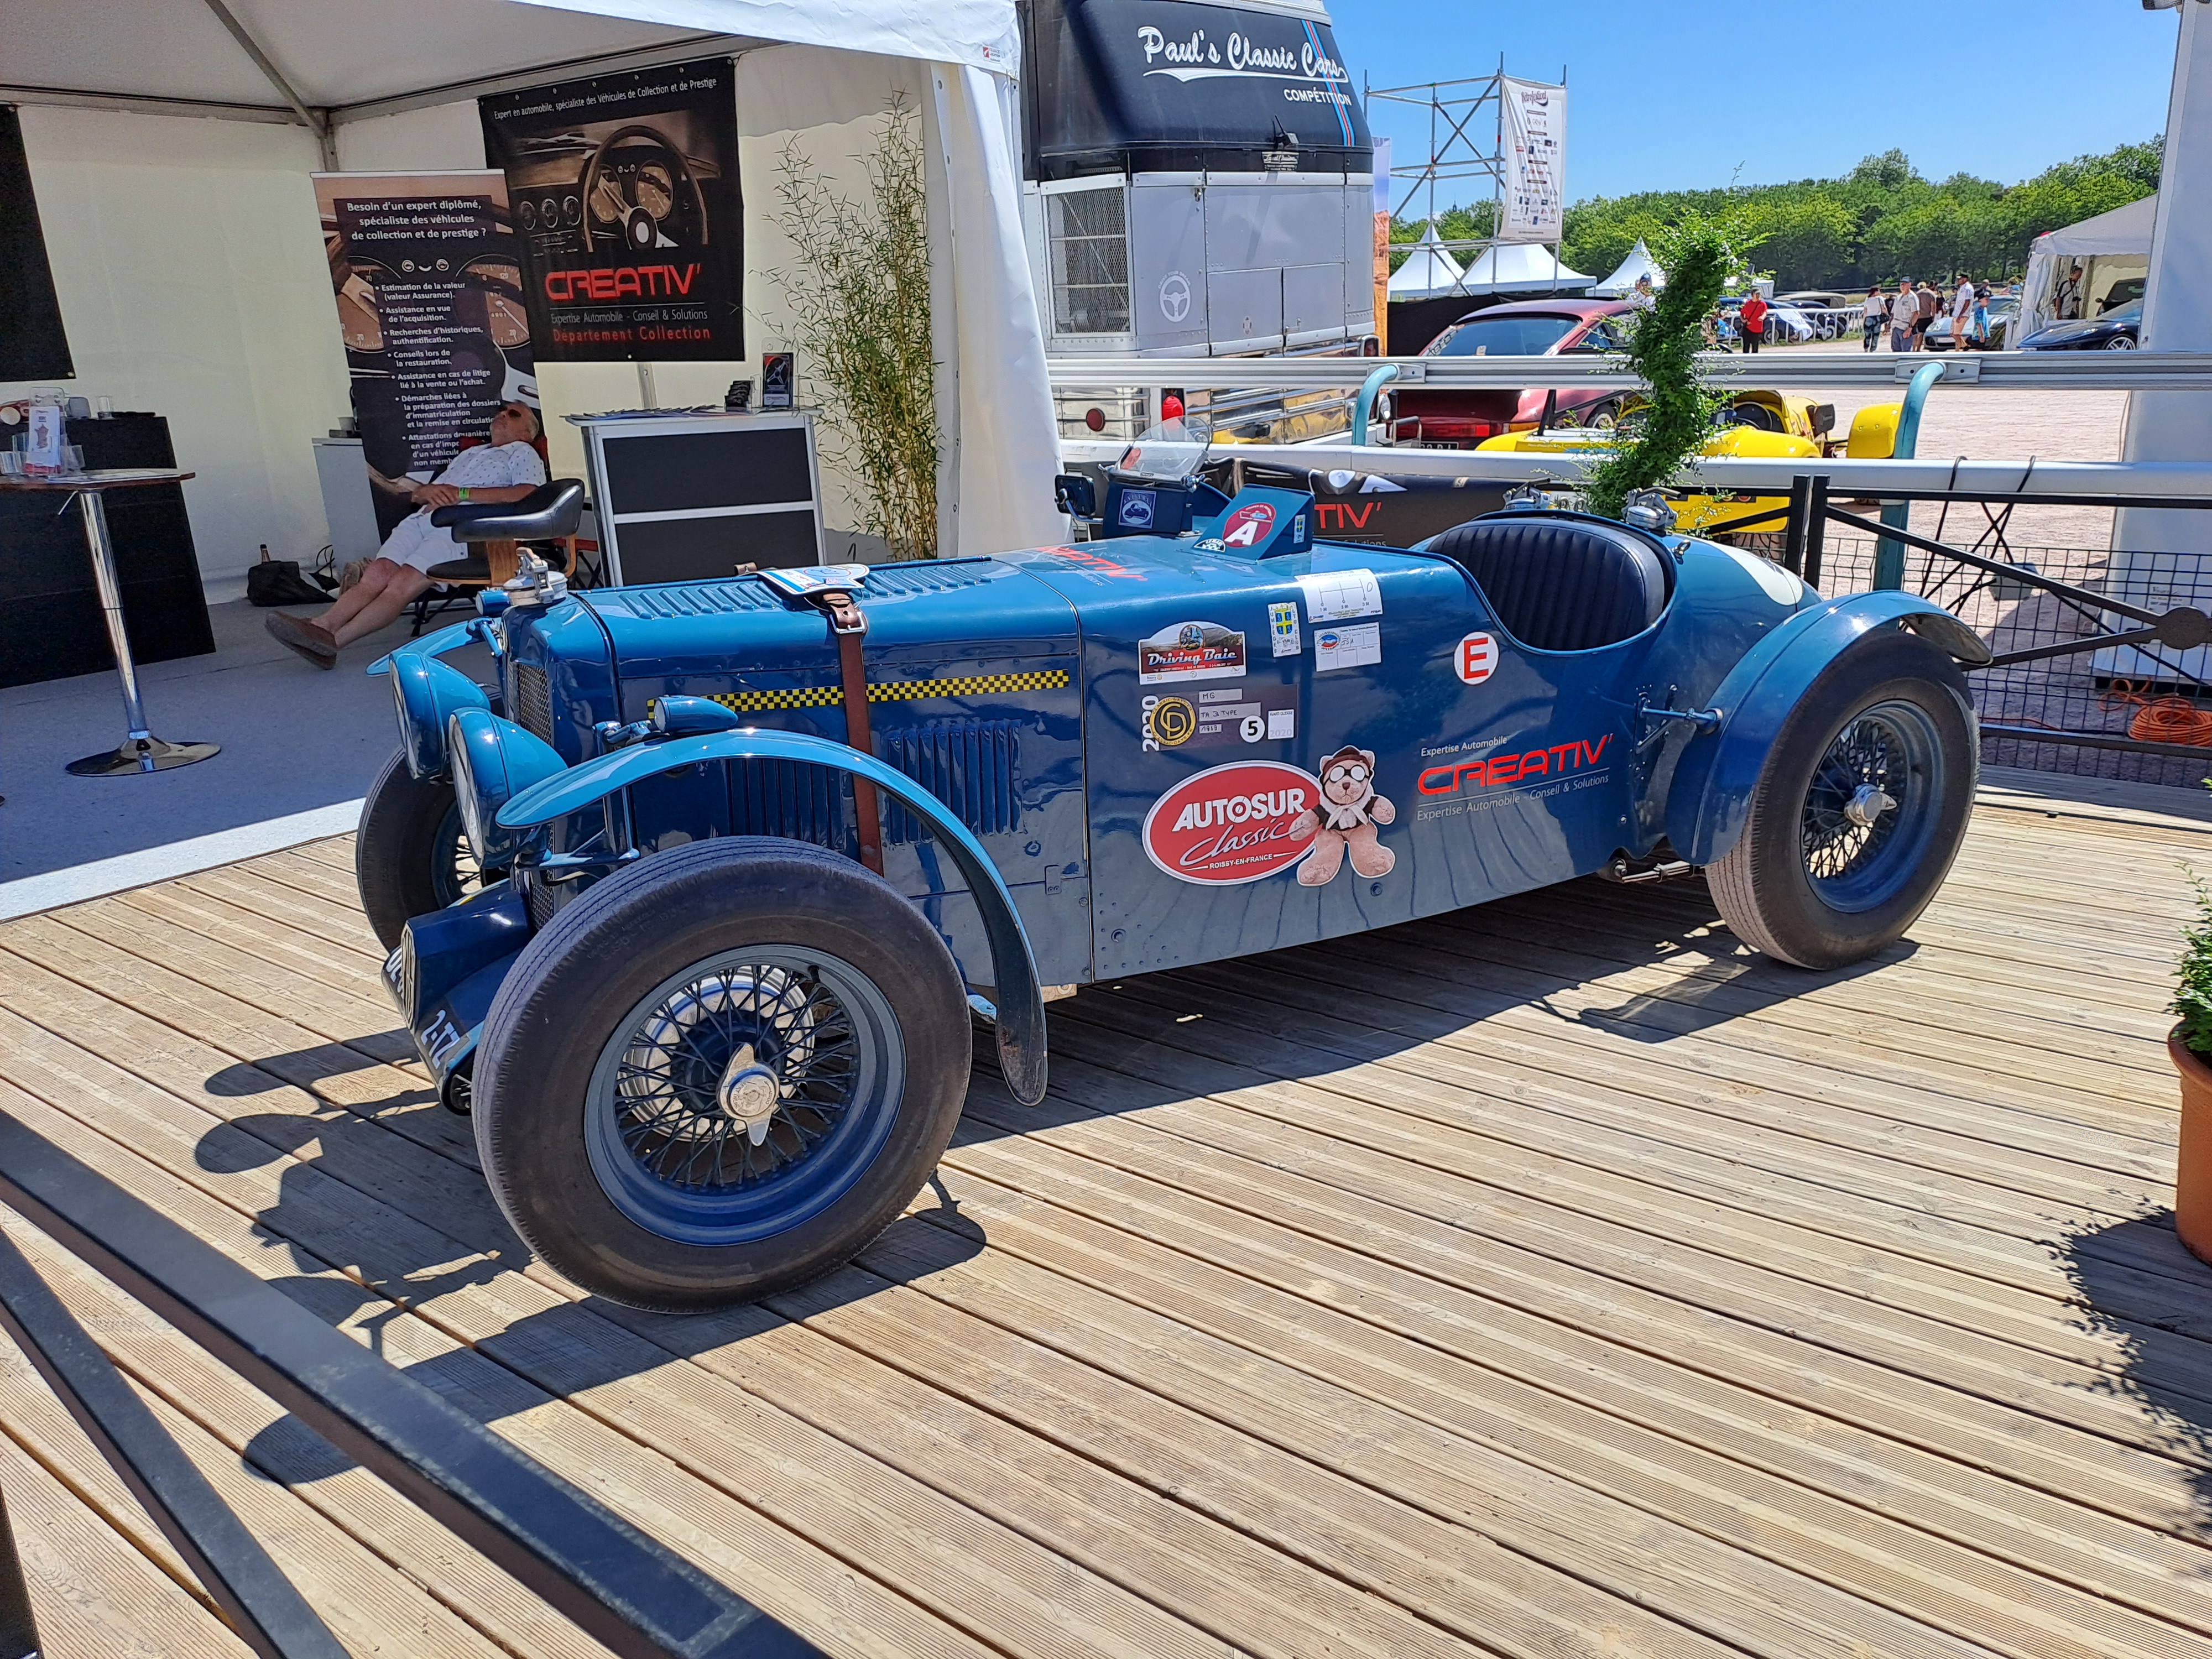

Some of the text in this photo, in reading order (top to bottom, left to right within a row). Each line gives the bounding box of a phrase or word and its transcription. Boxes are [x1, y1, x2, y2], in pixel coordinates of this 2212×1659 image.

[1137, 25, 1347, 79] Paul's Classic Cars
[494, 109, 512, 120] Expert
[521, 102, 555, 116] automobile,
[555, 98, 585, 112] spécialiste
[586, 95, 597, 106] des
[597, 90, 627, 104] Véhicules
[628, 90, 637, 99] de
[637, 85, 670, 98] Collection
[670, 82, 679, 93] et
[679, 82, 688, 91] de
[690, 77, 717, 90] Prestige
[1283, 87, 1353, 107] COMPÉTITION
[347, 199, 482, 212] Besoin d'un expert diplômé,
[359, 213, 475, 227] spécialiste des véhicules
[351, 227, 487, 241] de collection et de prestige ?
[381, 284, 421, 292] Estimation
[384, 291, 456, 302] (valeur Assurance).
[399, 314, 447, 324] l'acquisition.
[550, 312, 581, 326] Expertise
[583, 311, 624, 323] Automobile
[633, 310, 660, 322] Conseil
[662, 309, 670, 320] &
[671, 309, 708, 321] Solutions
[389, 326, 484, 337] Recherches d'historiques,
[553, 325, 712, 343] Département Collection
[392, 336, 454, 345] authentification.
[393, 350, 425, 359] Conseils
[405, 358, 452, 367] restauration.
[397, 372, 436, 381] Assistance
[472, 369, 491, 377] litige
[401, 394, 442, 403] Démarches
[412, 402, 456, 411] préparation
[471, 399, 501, 407] dossiers
[405, 410, 471, 420] d'immatriculation
[408, 432, 452, 441] Attestations
[412, 450, 429, 458] d'un
[1224, 520, 1259, 546] A
[1146, 647, 1238, 666] Driving Baie
[1463, 637, 1489, 680] E
[1202, 692, 1215, 700] MG
[1246, 719, 1259, 737] 5
[1269, 728, 1293, 738] 2020
[1421, 735, 1508, 758] Expertise Automobile
[1417, 805, 1463, 822] Expertise
[1465, 792, 1521, 813] Automobile
[1529, 784, 1560, 801] Conseil
[1563, 781, 1570, 793] &
[1572, 774, 1610, 791] Solutions
[1171, 788, 1306, 832] AUTOSUR
[1179, 818, 1305, 867] Classic
[1209, 852, 1274, 870] ROISSY-EN-FRANCE
